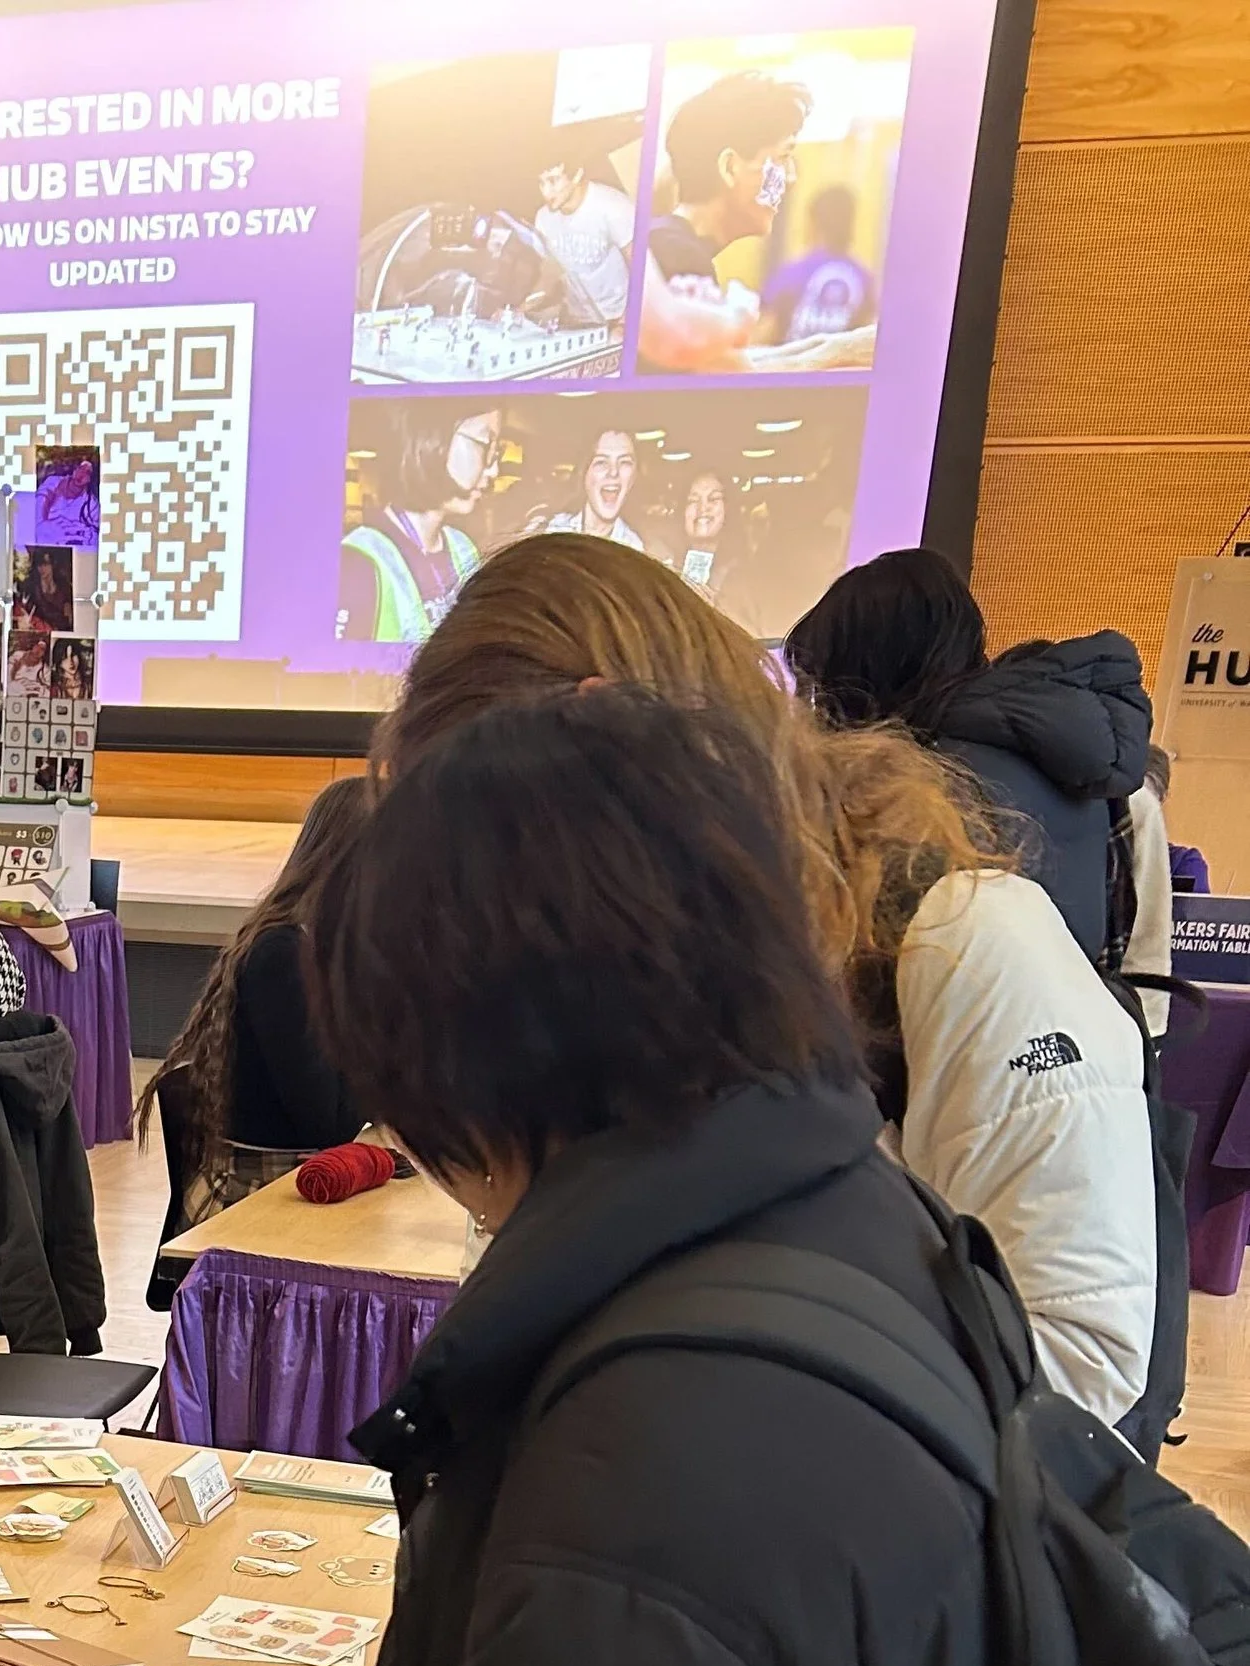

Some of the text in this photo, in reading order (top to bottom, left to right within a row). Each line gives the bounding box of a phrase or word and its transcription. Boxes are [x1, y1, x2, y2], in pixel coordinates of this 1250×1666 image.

[159, 87, 204, 129] IN
[211, 77, 341, 125] MORE
[75, 150, 255, 198] EVENTS?
[34, 219, 70, 246] US
[74, 217, 115, 244] ON
[120, 212, 200, 243] INSTA
[203, 210, 241, 238] TO
[244, 206, 317, 236] STAY
[49, 256, 176, 287] UPDATED
[1192, 623, 1224, 643] the
[1028, 1033, 1056, 1051] THE
[1008, 1043, 1058, 1071] NORTH
[1027, 1056, 1064, 1077] FACE
